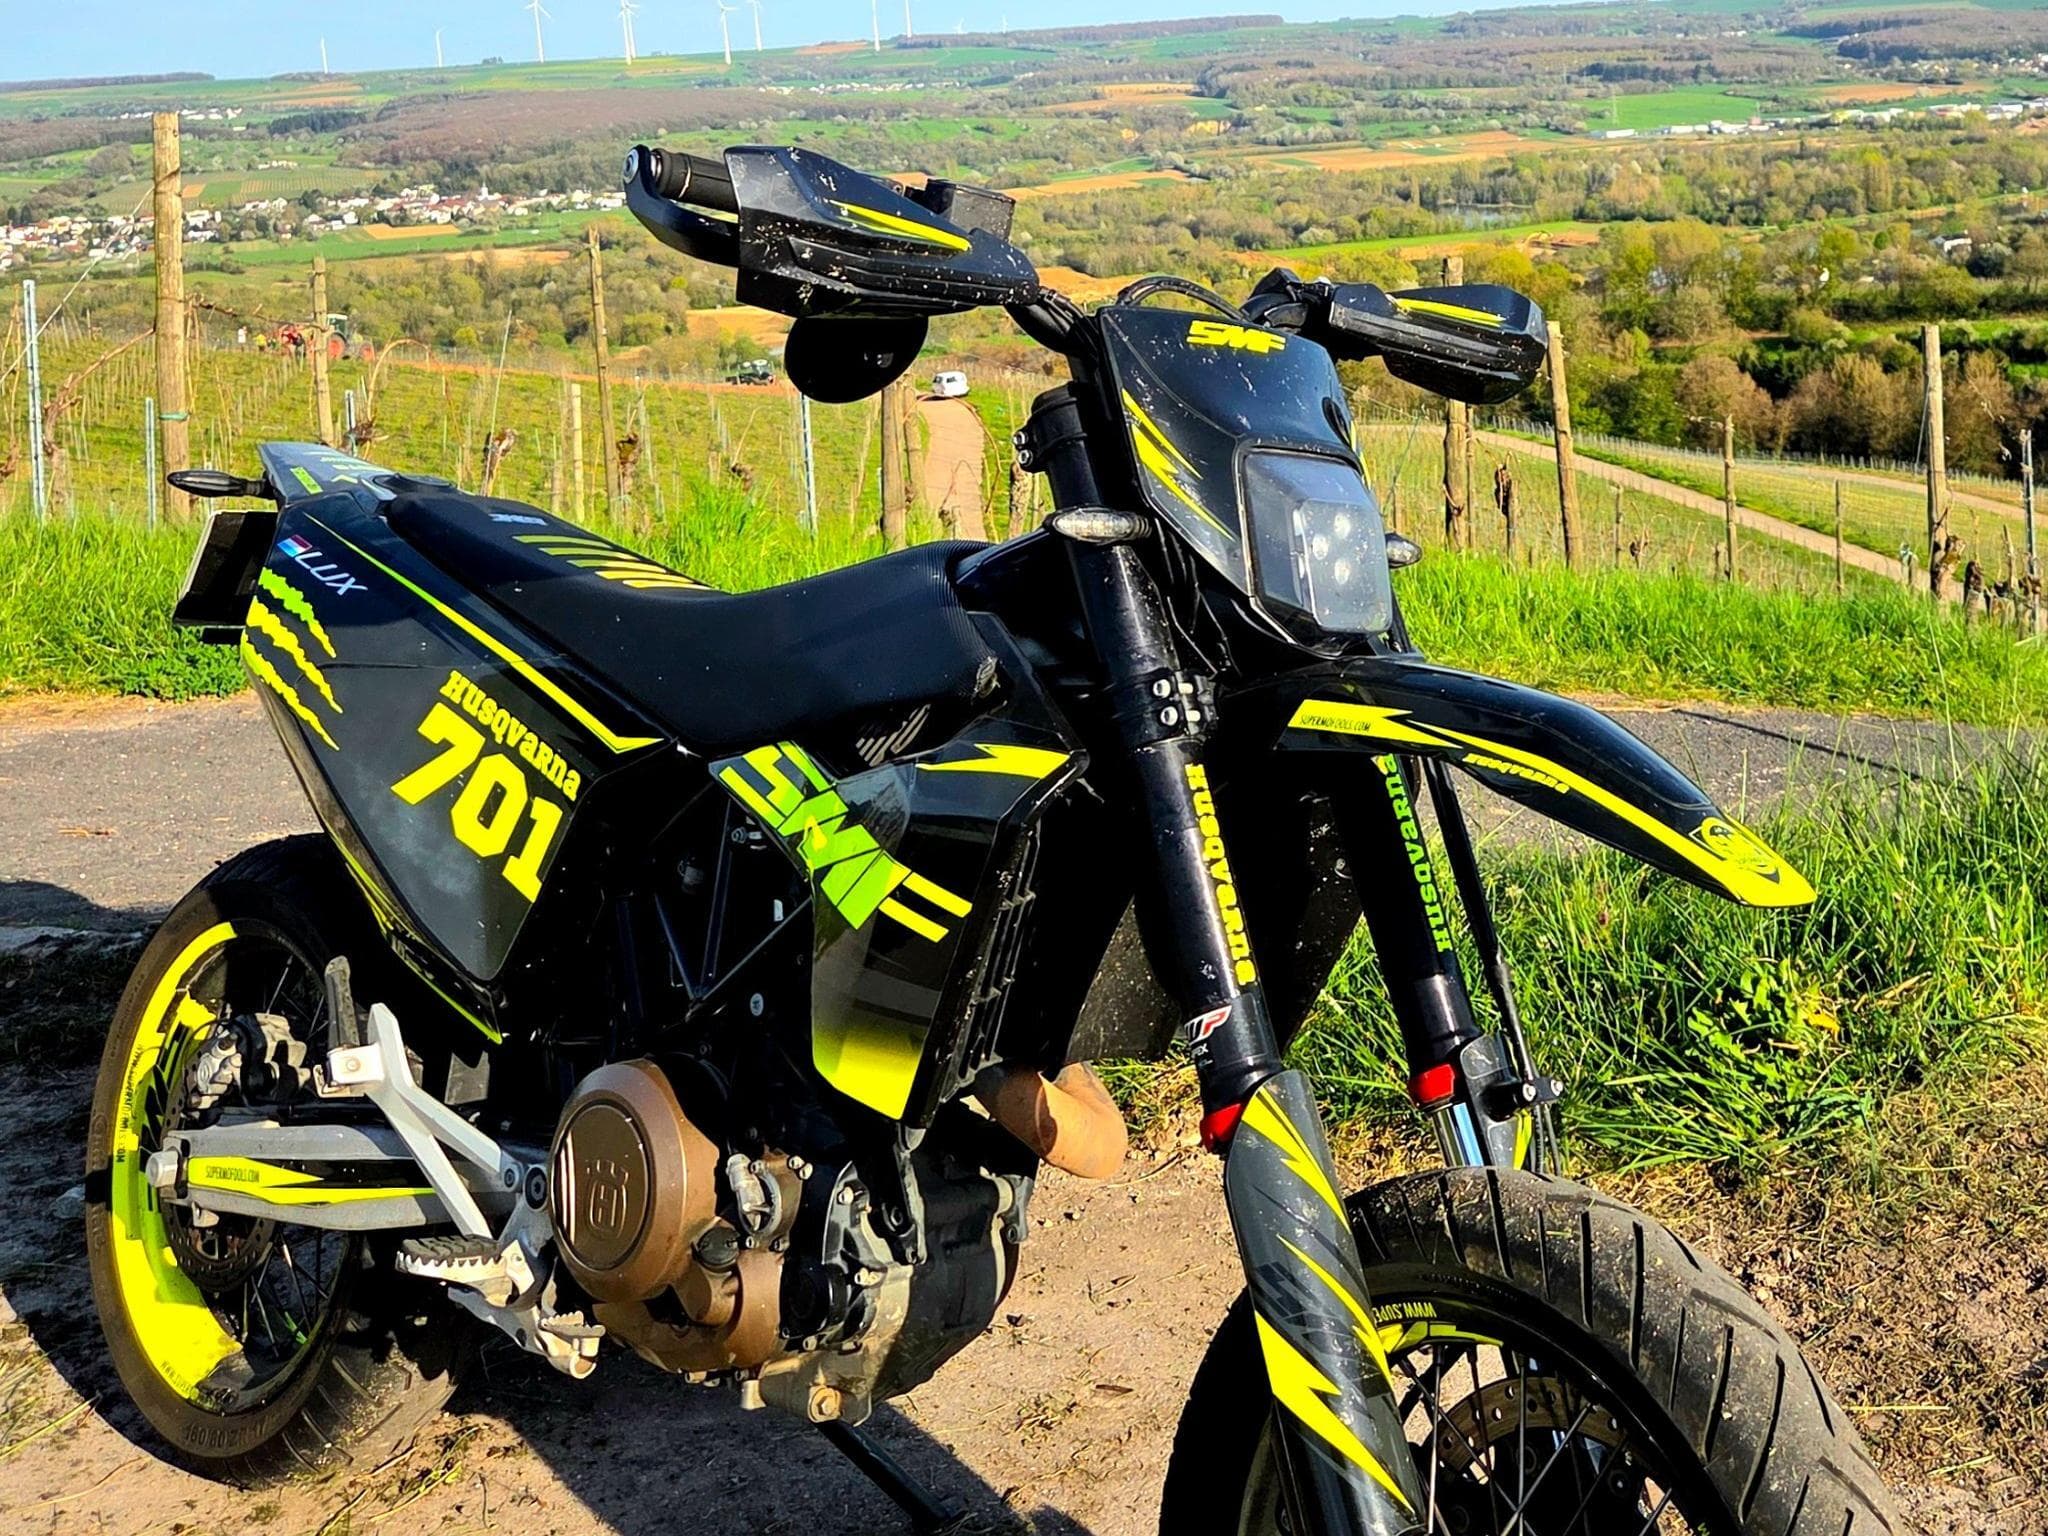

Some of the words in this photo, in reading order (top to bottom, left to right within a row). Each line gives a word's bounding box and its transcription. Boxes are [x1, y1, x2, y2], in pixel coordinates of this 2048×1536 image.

[1186, 320, 1286, 353] SMF
[294, 551, 368, 596] LUX
[390, 702, 564, 904] 701
